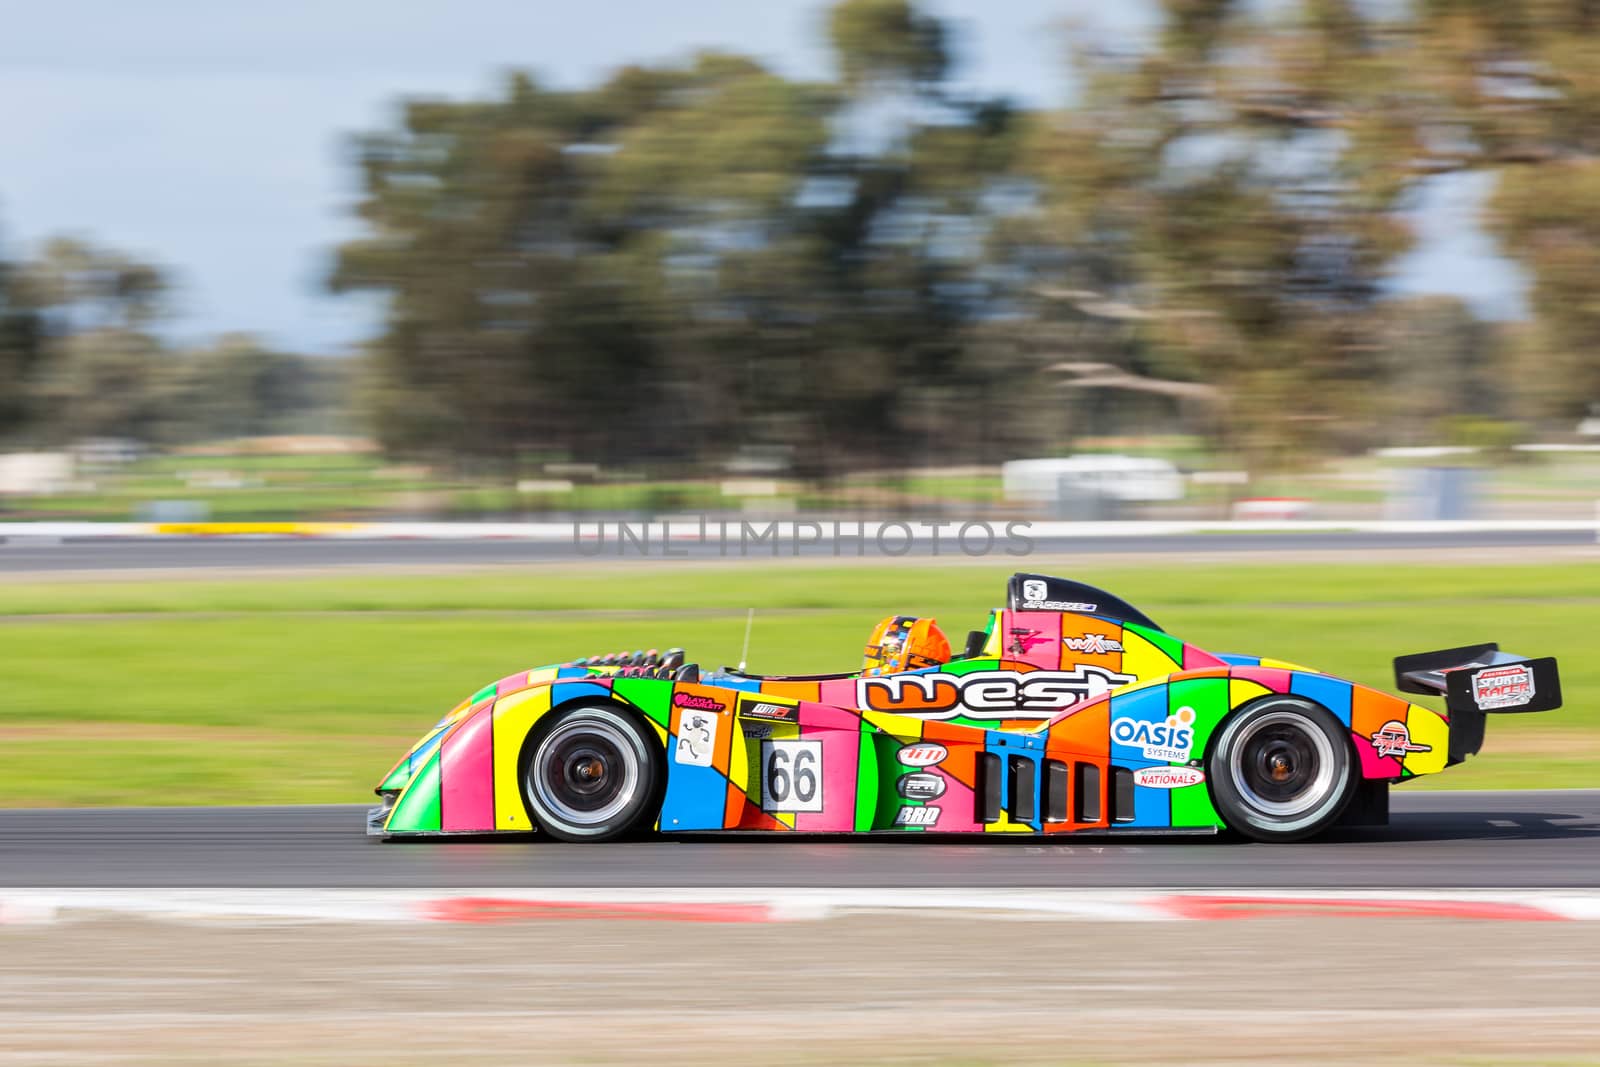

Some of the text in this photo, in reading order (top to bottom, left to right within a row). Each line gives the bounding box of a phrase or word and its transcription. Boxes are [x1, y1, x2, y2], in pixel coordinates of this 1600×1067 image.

[1478, 673, 1529, 689] SPORTS
[1478, 683, 1530, 698] RACER
[1115, 721, 1190, 750] OASIS
[1147, 747, 1186, 760] SYSTEMS
[767, 748, 817, 803] 66
[1140, 774, 1197, 785] NATIONALS
[895, 805, 940, 825] BRD
